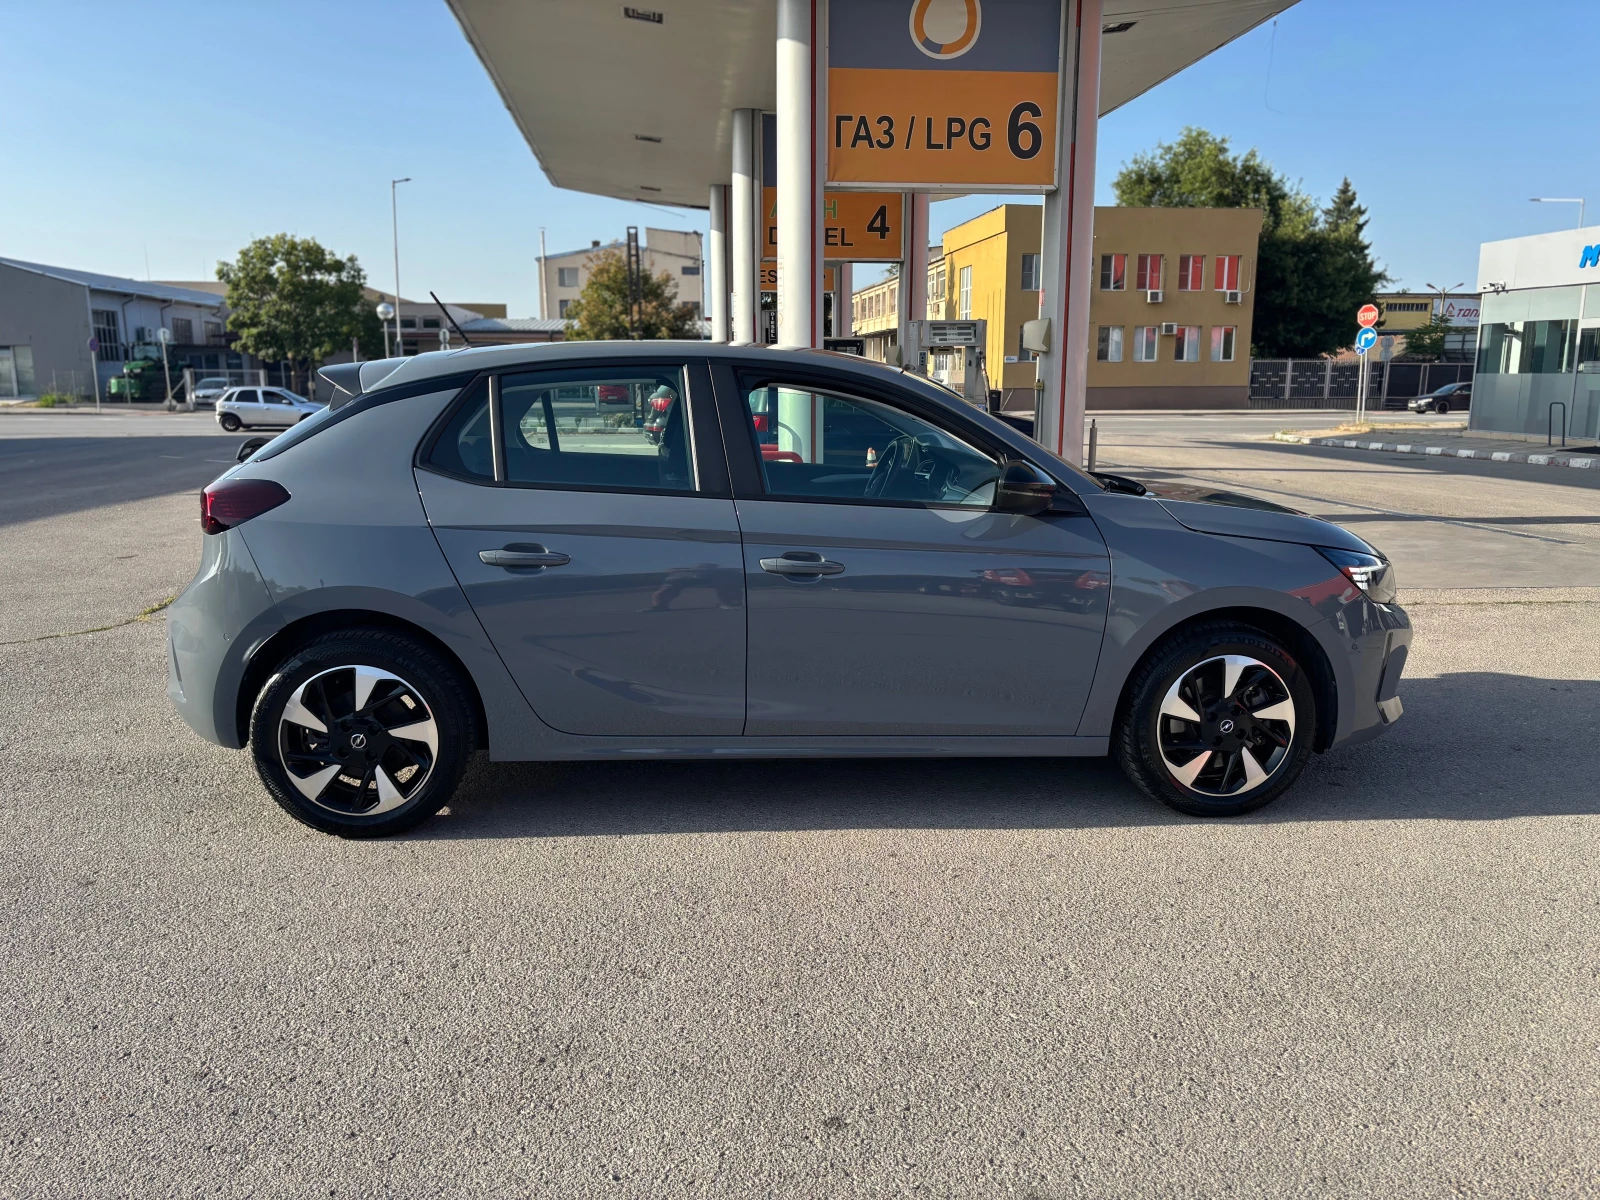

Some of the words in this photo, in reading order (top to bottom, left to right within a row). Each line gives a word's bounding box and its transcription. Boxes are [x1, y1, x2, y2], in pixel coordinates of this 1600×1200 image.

[834, 115, 895, 149] ГАЗ
[904, 116, 915, 150] /
[926, 117, 992, 151] LPG
[1007, 101, 1043, 160] 6
[866, 205, 890, 240] 4
[1359, 311, 1376, 322] STOP
